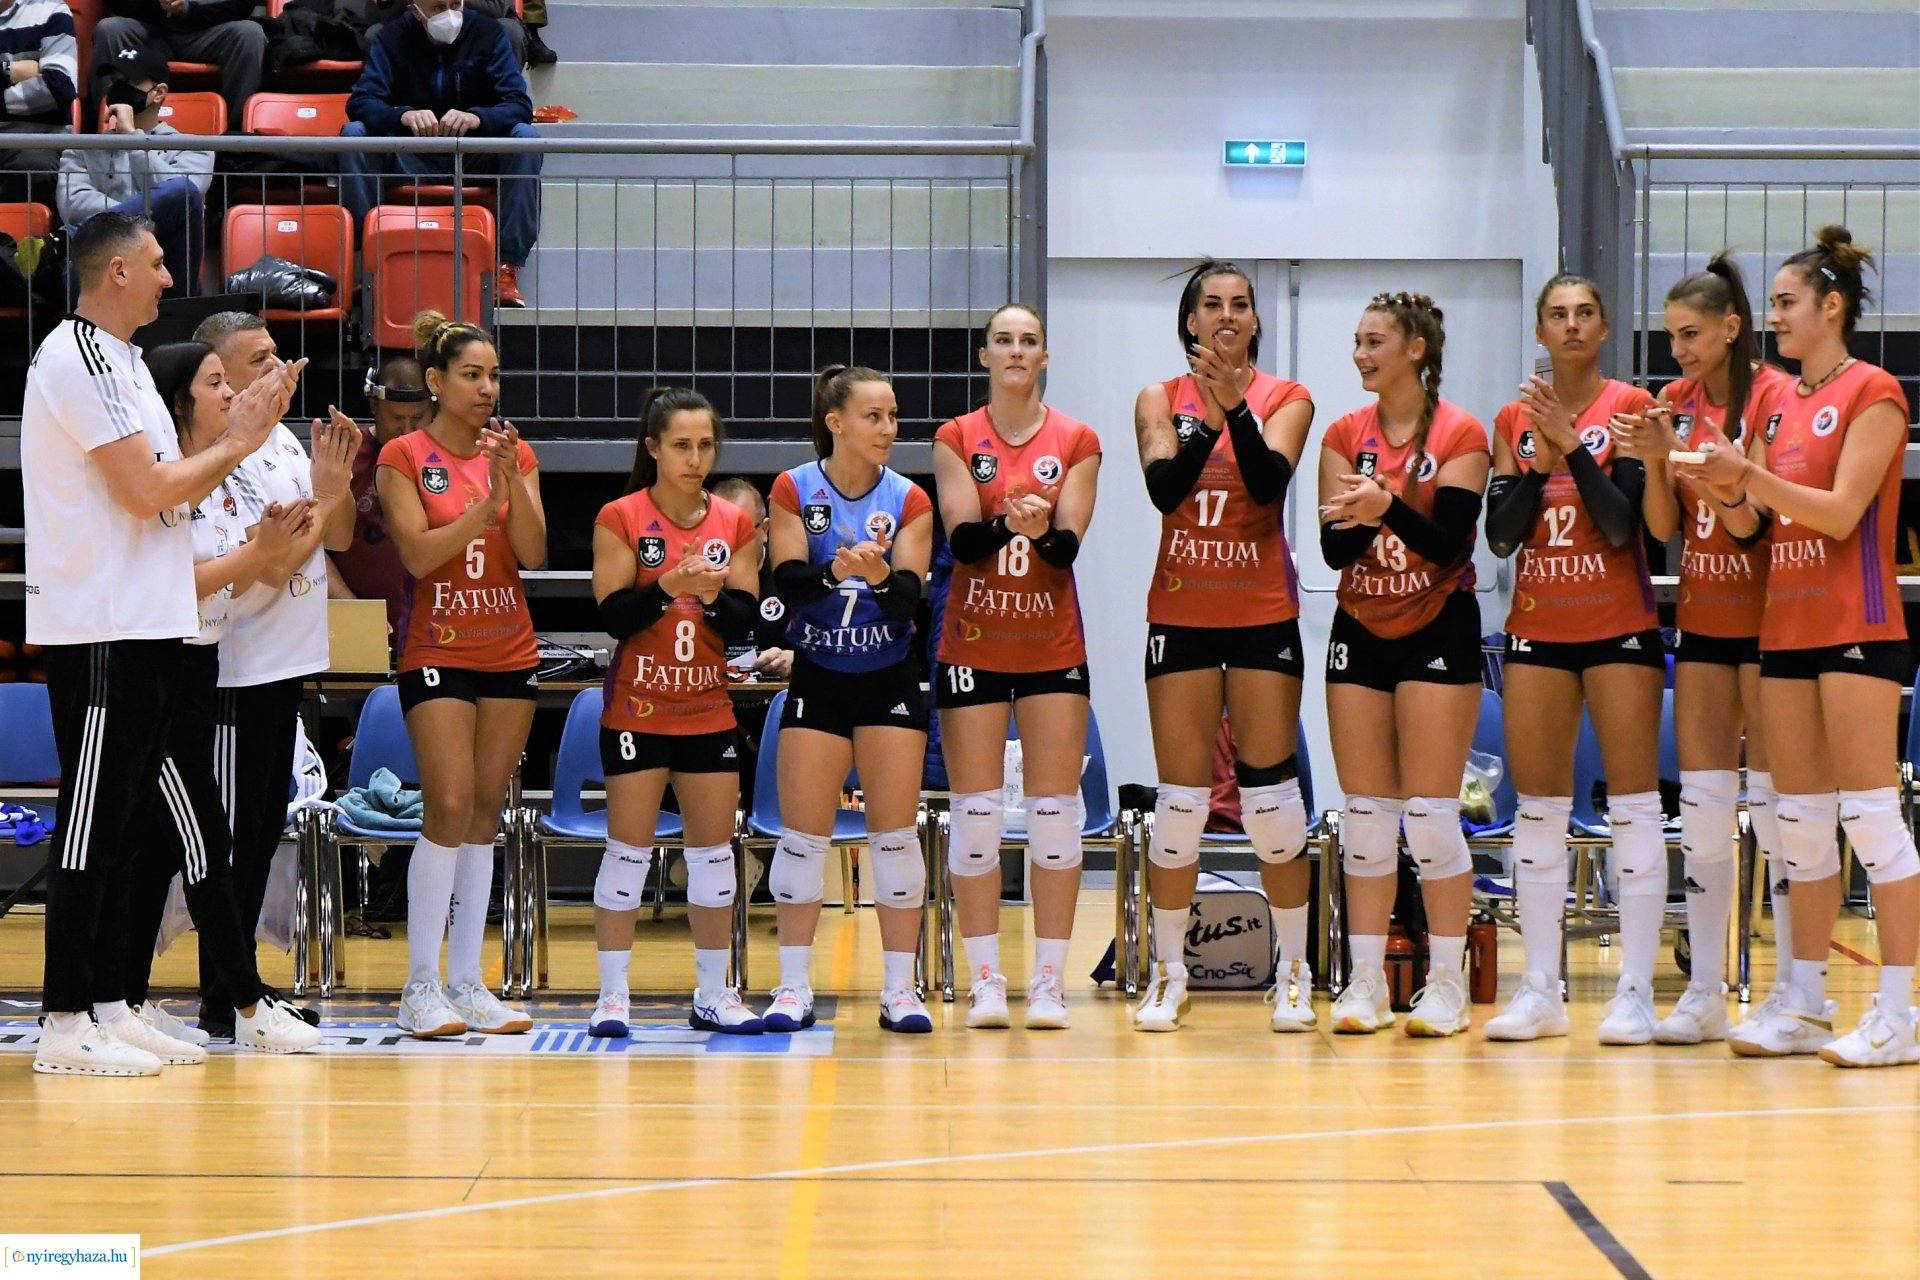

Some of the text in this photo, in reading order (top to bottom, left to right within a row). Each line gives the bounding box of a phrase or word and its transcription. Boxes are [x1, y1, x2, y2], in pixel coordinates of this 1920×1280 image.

[1195, 489, 1229, 527] 17
[1696, 499, 1715, 539] 9
[1543, 505, 1577, 546] 12
[465, 538, 486, 579] 5
[997, 535, 1031, 577] 18
[1167, 528, 1260, 561] FATUM
[1372, 534, 1408, 572] 13
[1771, 539, 1826, 564] TUM
[1520, 548, 1607, 577] FATUM
[432, 580, 517, 610] FATUM
[964, 577, 1056, 613] FATUM
[1350, 562, 1431, 596] FATUM
[432, 605, 518, 616] PROPERTY
[839, 589, 858, 627] 7
[674, 620, 696, 662] 8
[801, 623, 893, 648] FATUM
[1150, 634, 1166, 664] 17
[632, 654, 719, 686] FATUM
[1329, 641, 1348, 671] 13
[422, 667, 441, 687] 5
[947, 666, 975, 693] 18
[619, 731, 637, 760] 8
